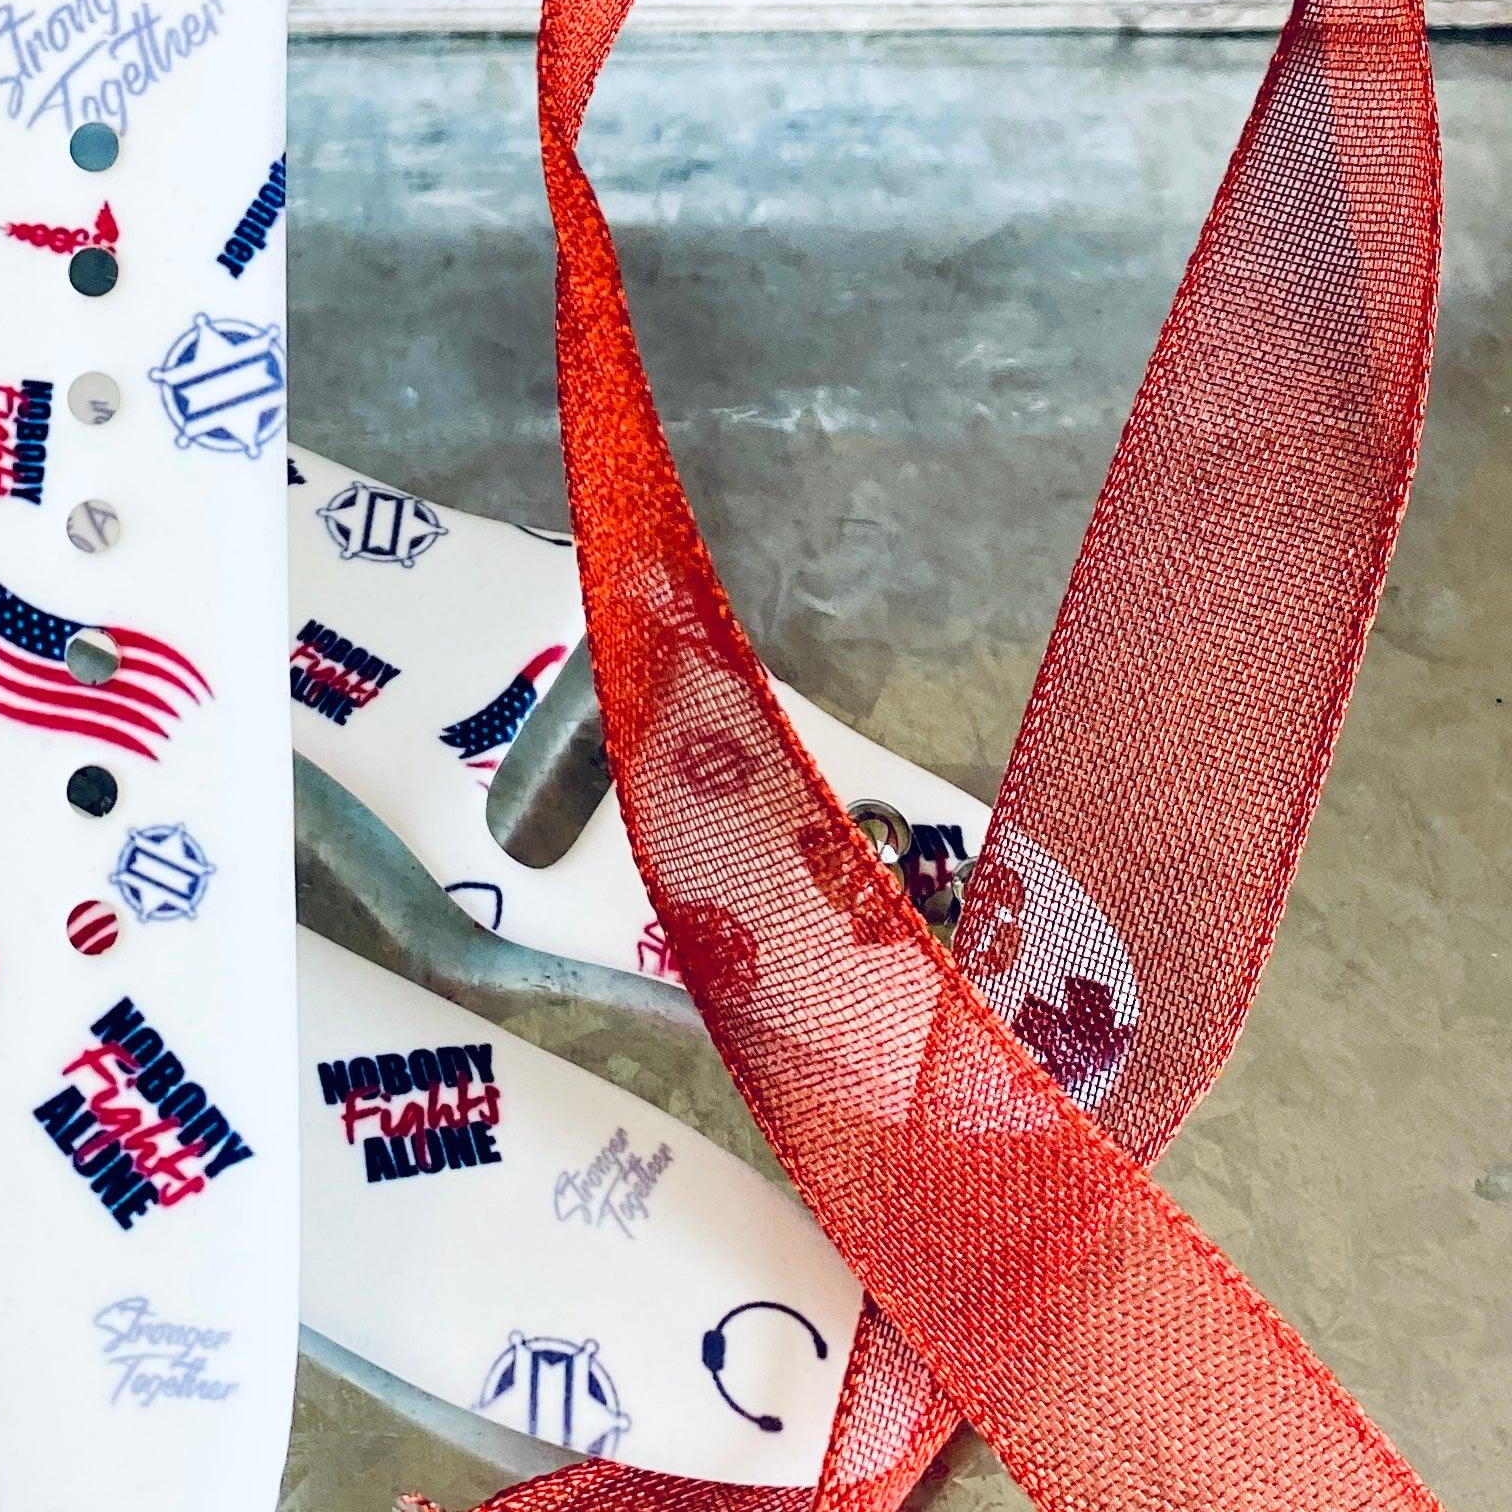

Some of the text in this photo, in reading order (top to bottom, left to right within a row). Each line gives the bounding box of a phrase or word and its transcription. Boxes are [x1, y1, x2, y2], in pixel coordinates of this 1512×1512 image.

[10, 379, 54, 506] NOBODY
[296, 618, 402, 690] NOBODY
[90, 995, 255, 1179] NOBODY
[317, 1043, 494, 1106] NOBODY
[32, 1085, 163, 1232] ALONE
[342, 1071, 502, 1169] Fights
[364, 1122, 503, 1183] ALONE
[94, 1295, 232, 1361] Stronger
